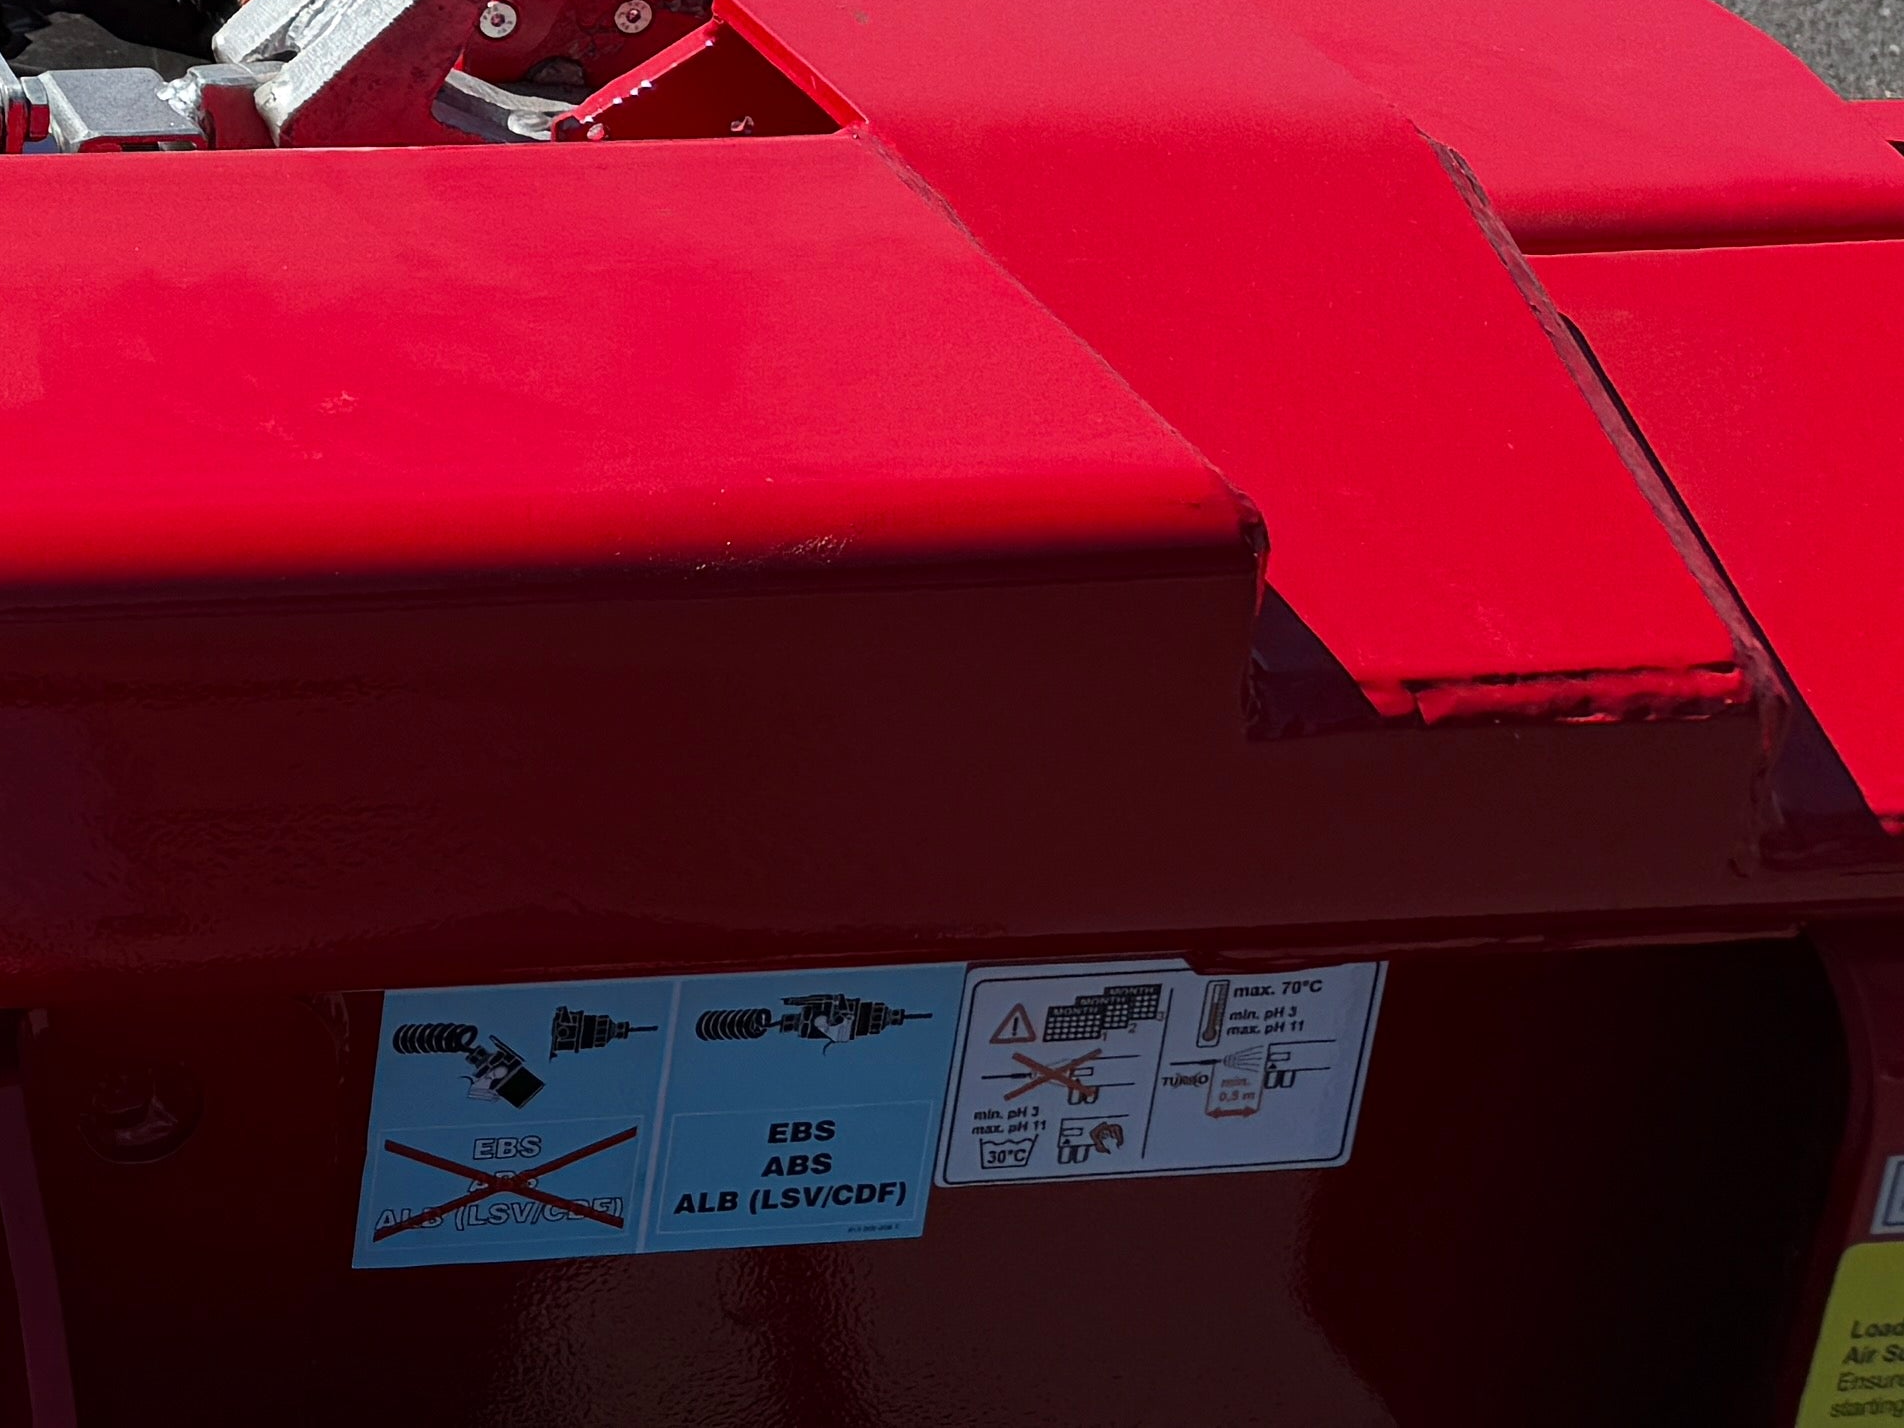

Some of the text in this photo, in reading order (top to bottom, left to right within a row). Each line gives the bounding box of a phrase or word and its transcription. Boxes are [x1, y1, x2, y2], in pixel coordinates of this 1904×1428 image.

[1109, 986, 1156, 996] MONTH
[1233, 979, 1323, 998] max. 70°C
[1080, 996, 1127, 1006] MONTH
[1052, 1006, 1100, 1016] MONTH
[1228, 1006, 1298, 1021] min. pH 3
[1226, 1020, 1305, 1036] max. pH 11
[1242, 1091, 1256, 1101] m
[974, 1105, 1040, 1121] min. pH 3
[767, 1119, 836, 1144] EBS
[972, 1120, 1046, 1135] max. pH 11
[472, 1135, 542, 1160] EBS
[987, 1148, 1027, 1164] 30°C
[760, 1152, 833, 1178] ABS
[673, 1180, 907, 1215] ALB (LSV/CDF)
[1842, 1345, 1879, 1365] Air
